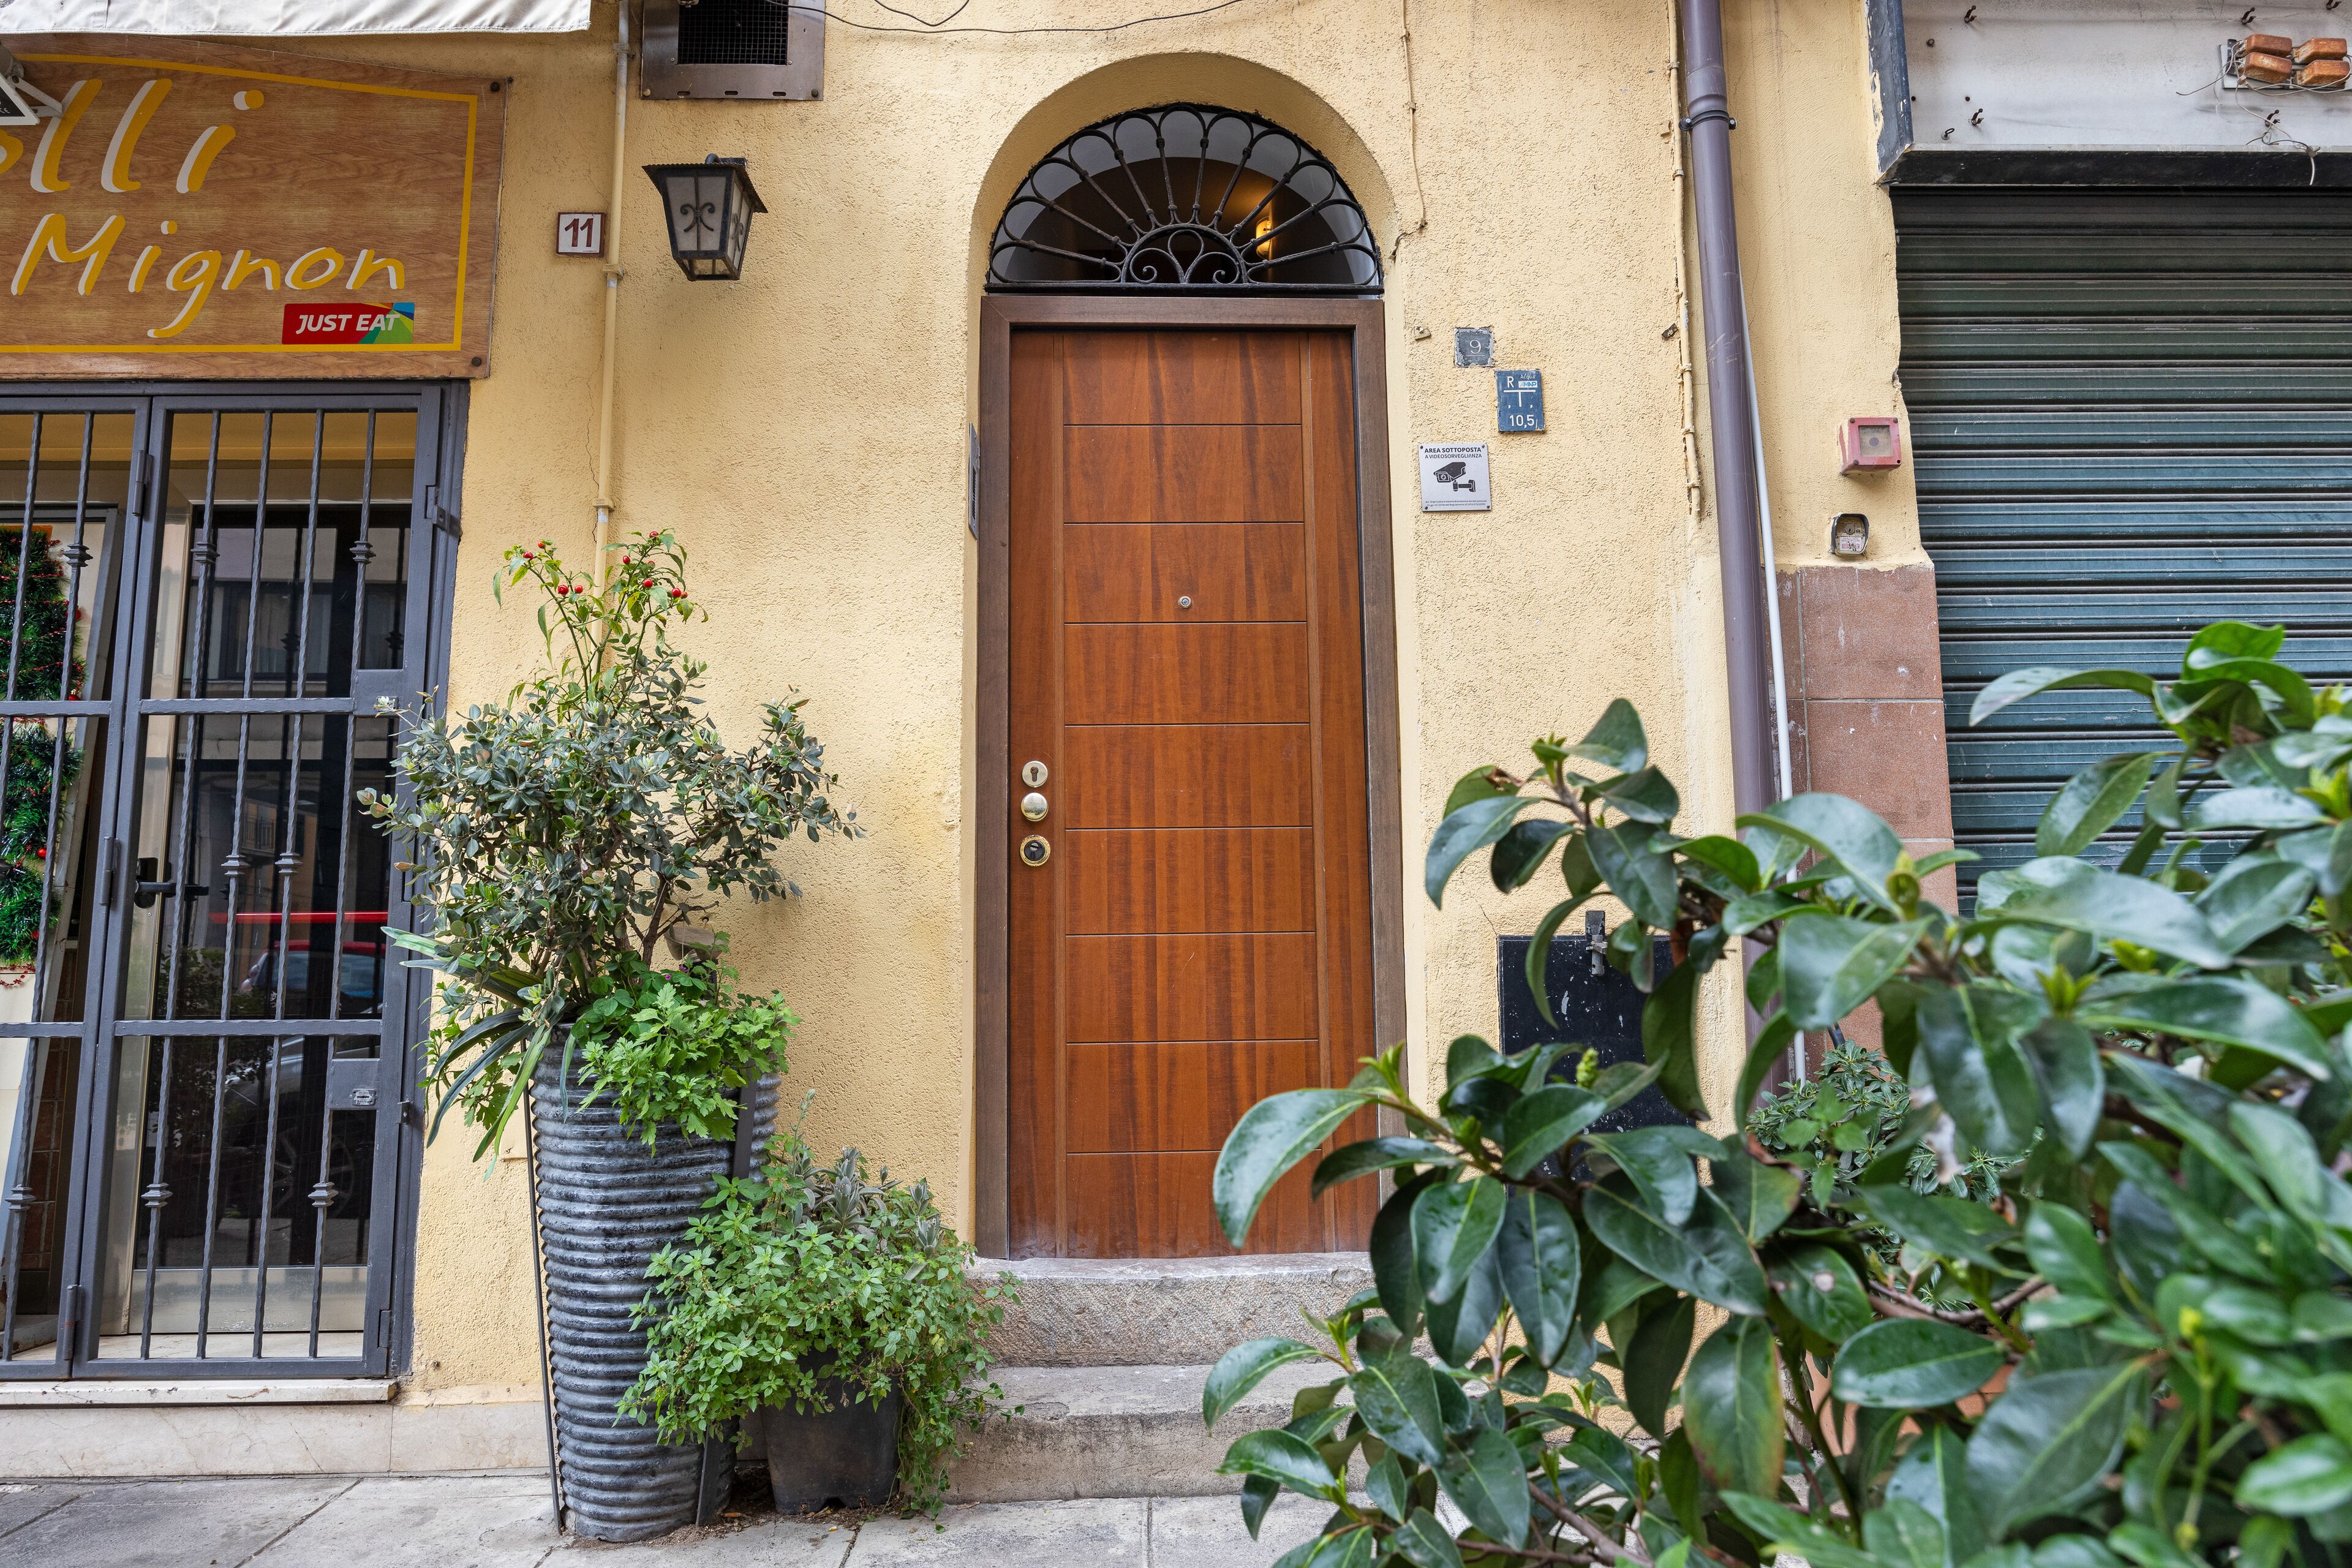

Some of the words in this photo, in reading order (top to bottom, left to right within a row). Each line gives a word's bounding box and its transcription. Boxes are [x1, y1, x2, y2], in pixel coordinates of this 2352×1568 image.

[0, 78, 265, 194] lli
[564, 218, 594, 247] 11
[11, 213, 405, 338] Mignon
[296, 314, 353, 335] JUST
[356, 314, 401, 331] EAT
[1469, 339, 1482, 354] 9
[1507, 376, 1515, 388] R
[1509, 414, 1535, 429] 10,5
